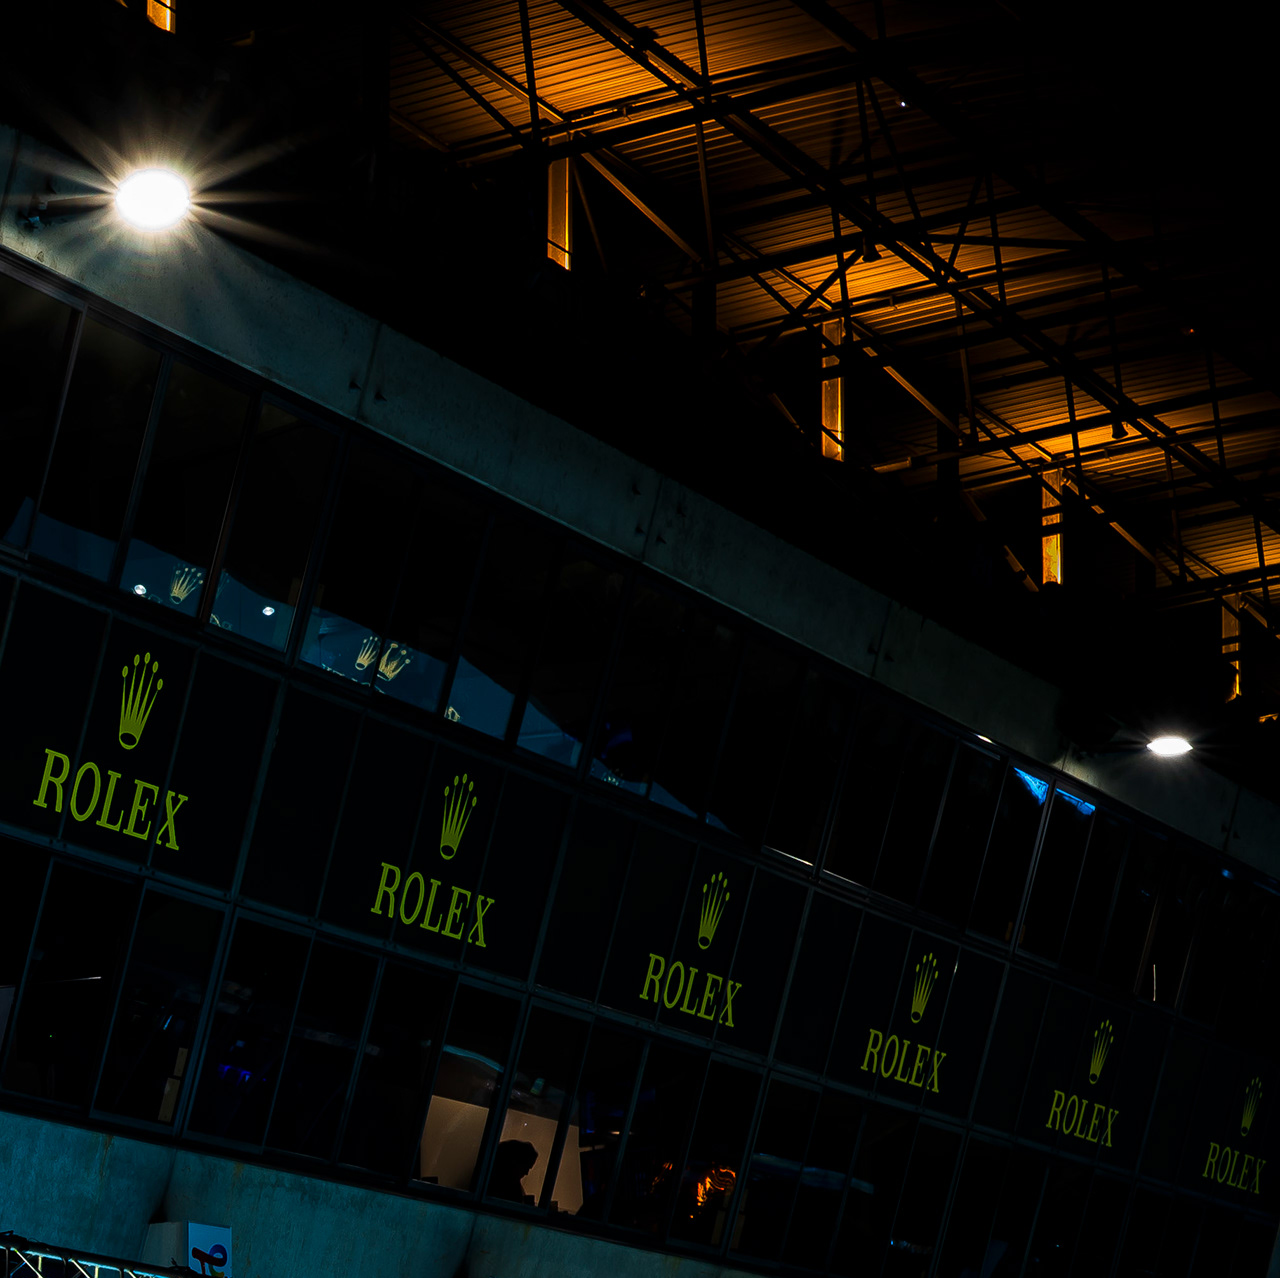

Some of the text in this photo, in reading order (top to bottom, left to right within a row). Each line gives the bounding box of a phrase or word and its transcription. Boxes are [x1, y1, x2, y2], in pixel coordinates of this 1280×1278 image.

[33, 749, 188, 850] ROLEX
[371, 862, 495, 947] ROLEX
[640, 954, 742, 1027] ROLEX
[861, 1029, 946, 1092] ROLEX
[1046, 1090, 1119, 1147] ROLEX
[1204, 1143, 1266, 1194] ROLEX
